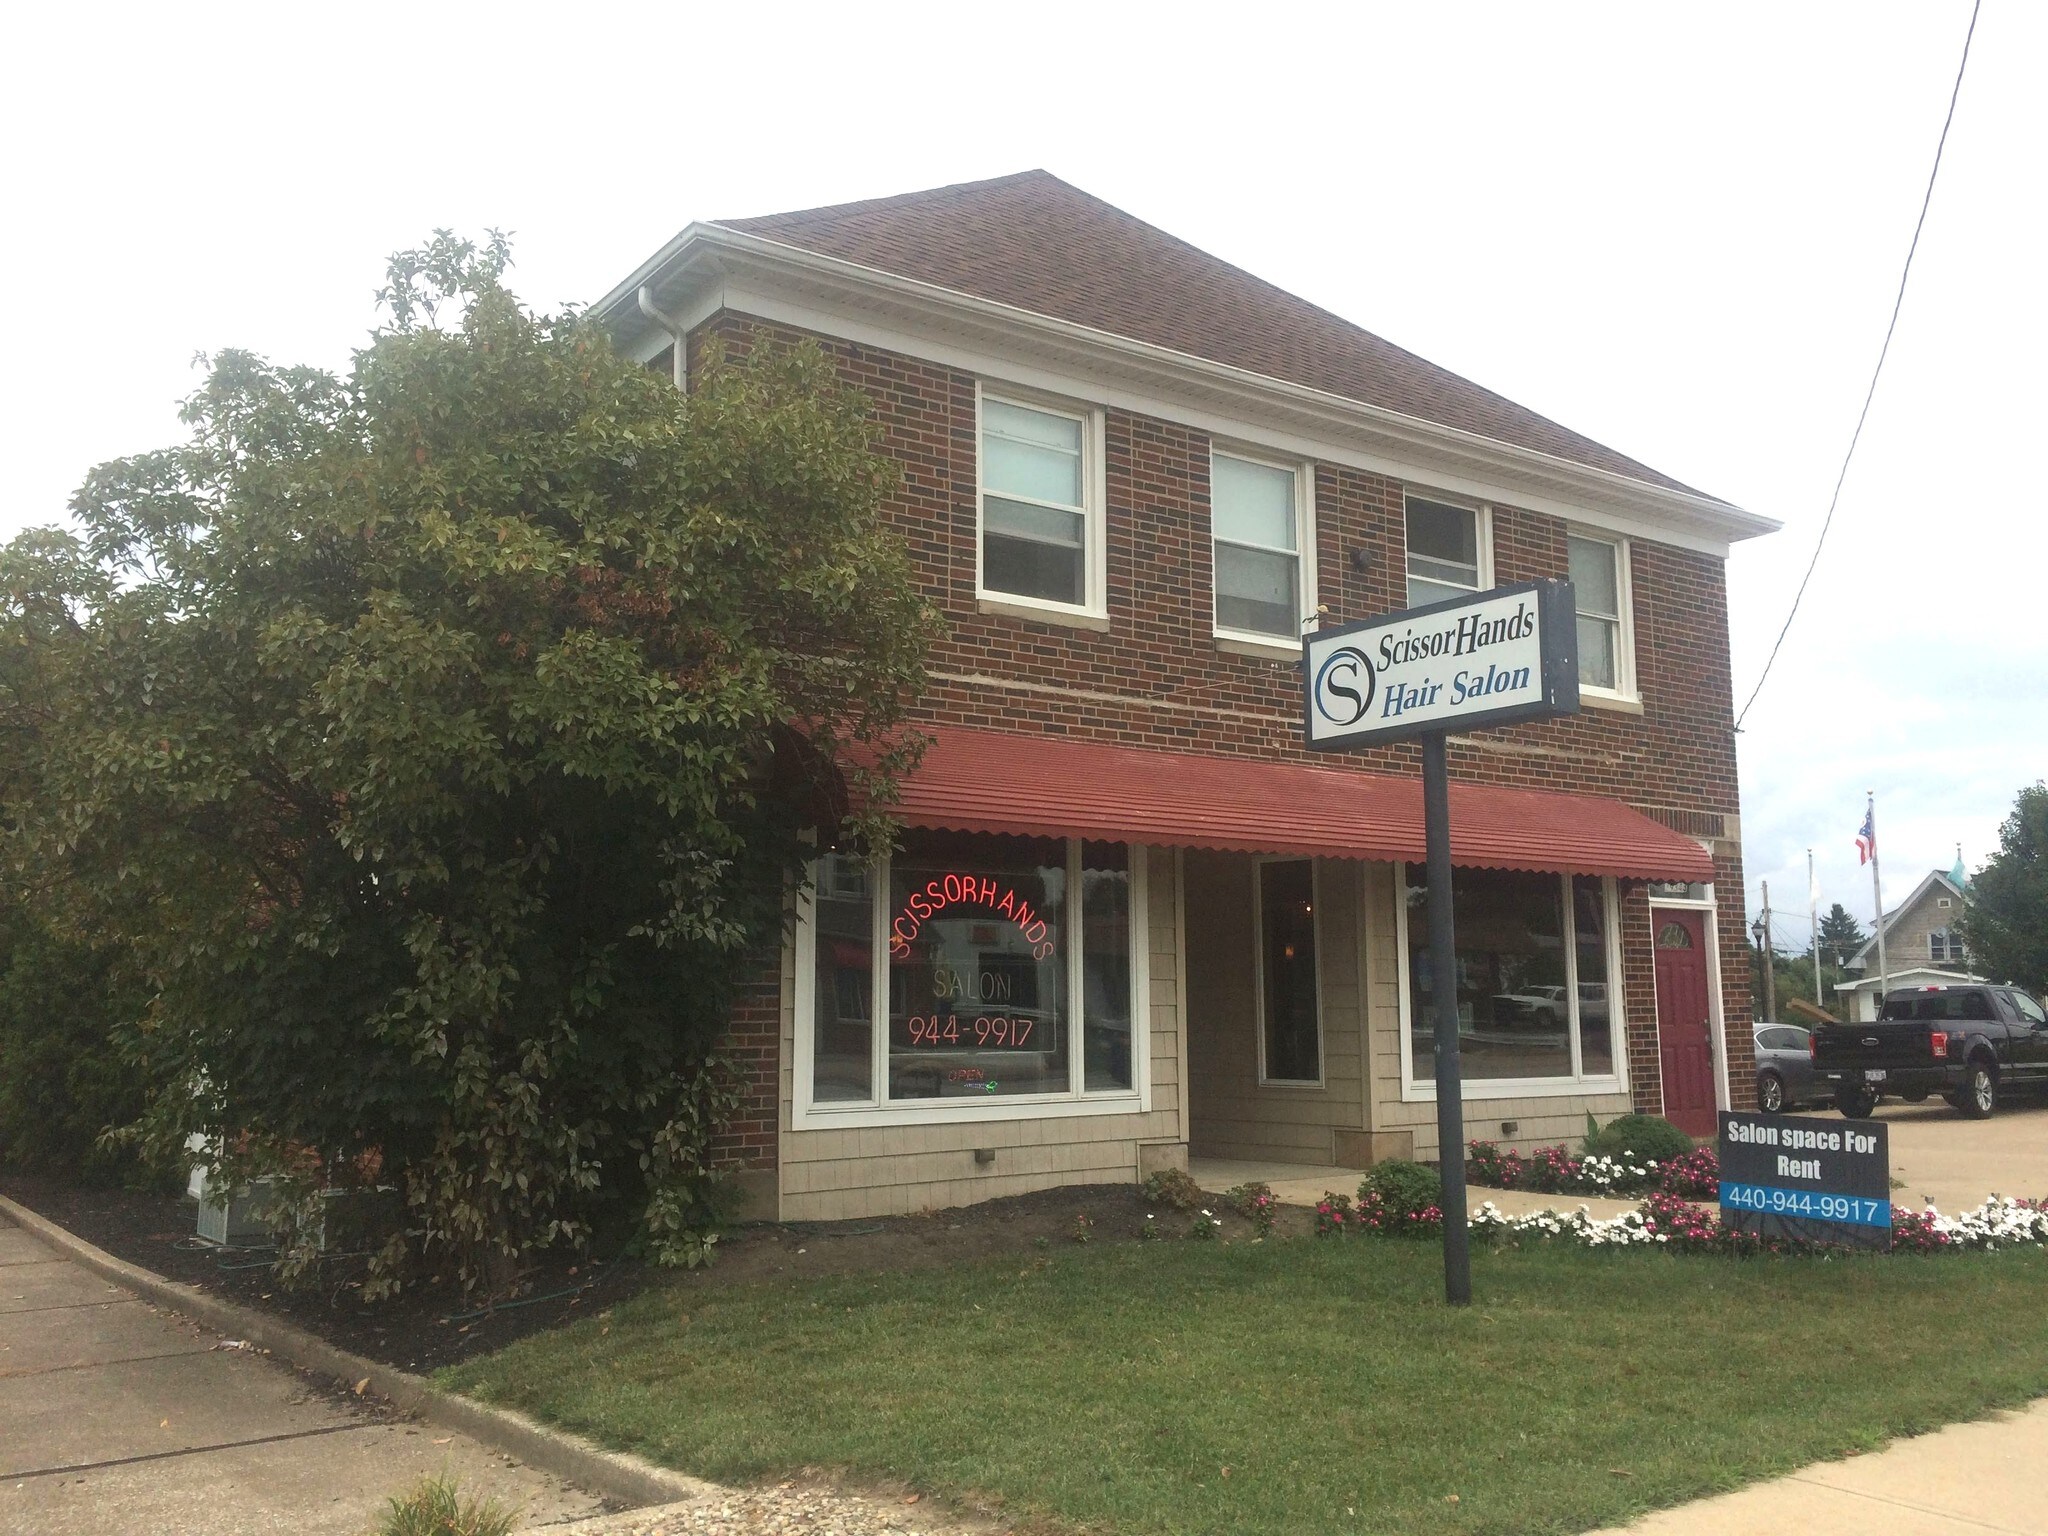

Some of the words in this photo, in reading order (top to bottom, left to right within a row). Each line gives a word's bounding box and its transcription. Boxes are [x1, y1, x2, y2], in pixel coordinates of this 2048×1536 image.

[1376, 602, 1535, 673] ScissorHands
[1380, 677, 1444, 719] Hair
[1450, 664, 1531, 706] Salon
[889, 874, 1054, 961] SCISSORHANDS
[933, 969, 1012, 1000] SALON
[909, 1015, 1034, 1047] 944-9917
[1728, 1120, 1778, 1146] Salon
[1782, 1128, 1841, 1151] space
[1845, 1130, 1877, 1154] For
[1777, 1155, 1822, 1180] Rent
[1729, 1187, 1879, 1222] 440-944-9917
